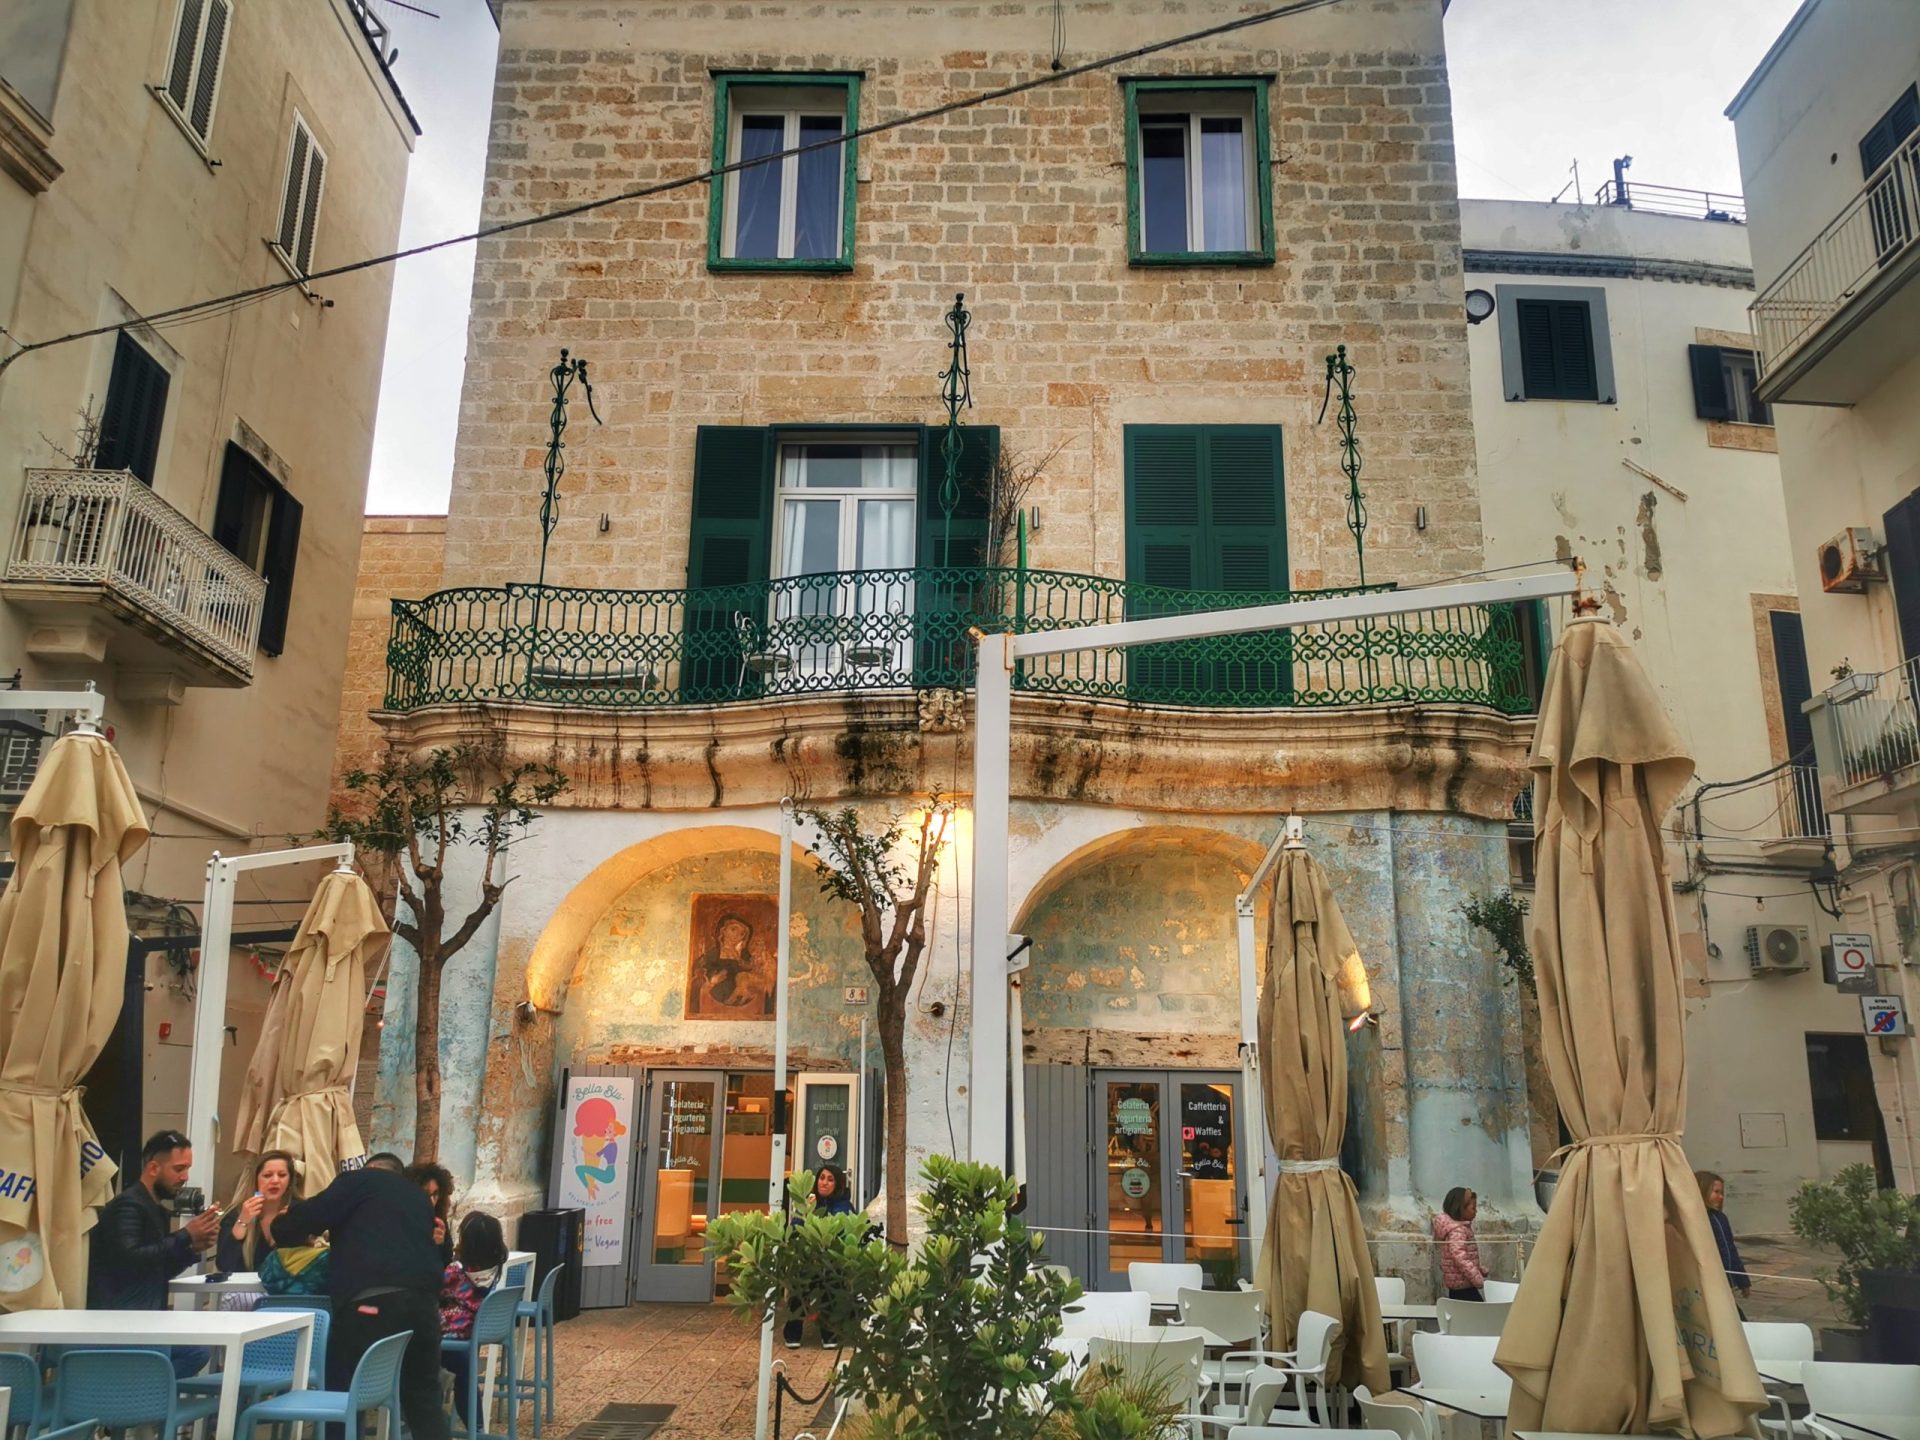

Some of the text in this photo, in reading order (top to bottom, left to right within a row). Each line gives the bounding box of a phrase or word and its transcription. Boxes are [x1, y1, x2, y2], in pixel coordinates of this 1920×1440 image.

[848, 988, 856, 999] 8
[575, 1083, 602, 1101] Bella
[1117, 1100, 1150, 1110] Gelateria
[1188, 1101, 1227, 1111] Caffetteria
[1116, 1114, 1152, 1125] Yogurteria
[1218, 1115, 1225, 1125] &
[1115, 1125, 1153, 1136] artigianale
[1195, 1126, 1222, 1136] Waffles
[594, 1214, 614, 1227] free
[594, 1234, 620, 1250] Vegan
